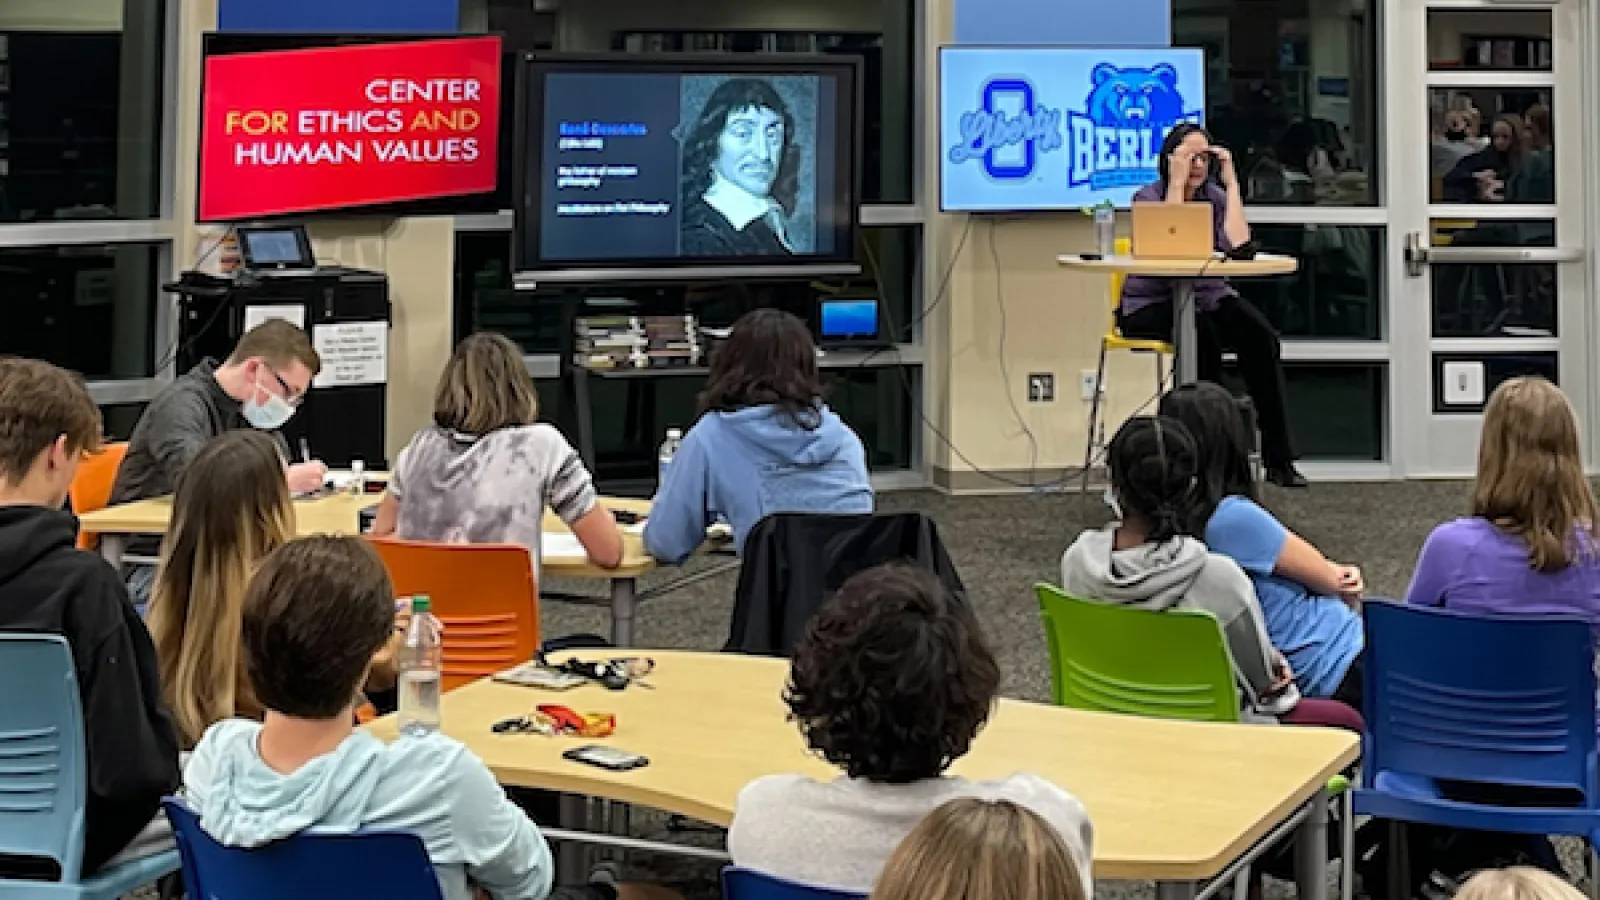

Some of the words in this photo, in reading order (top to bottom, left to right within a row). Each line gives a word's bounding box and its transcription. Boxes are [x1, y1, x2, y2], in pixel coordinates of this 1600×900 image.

[365, 79, 481, 103] CENTER
[225, 111, 289, 135] FOR
[297, 109, 404, 134] ETHICS
[410, 109, 481, 132] AND
[949, 103, 1062, 164] Liberty
[234, 141, 363, 166] HUMAN
[372, 138, 480, 162] VALUES
[1068, 115, 1198, 184] BERL
